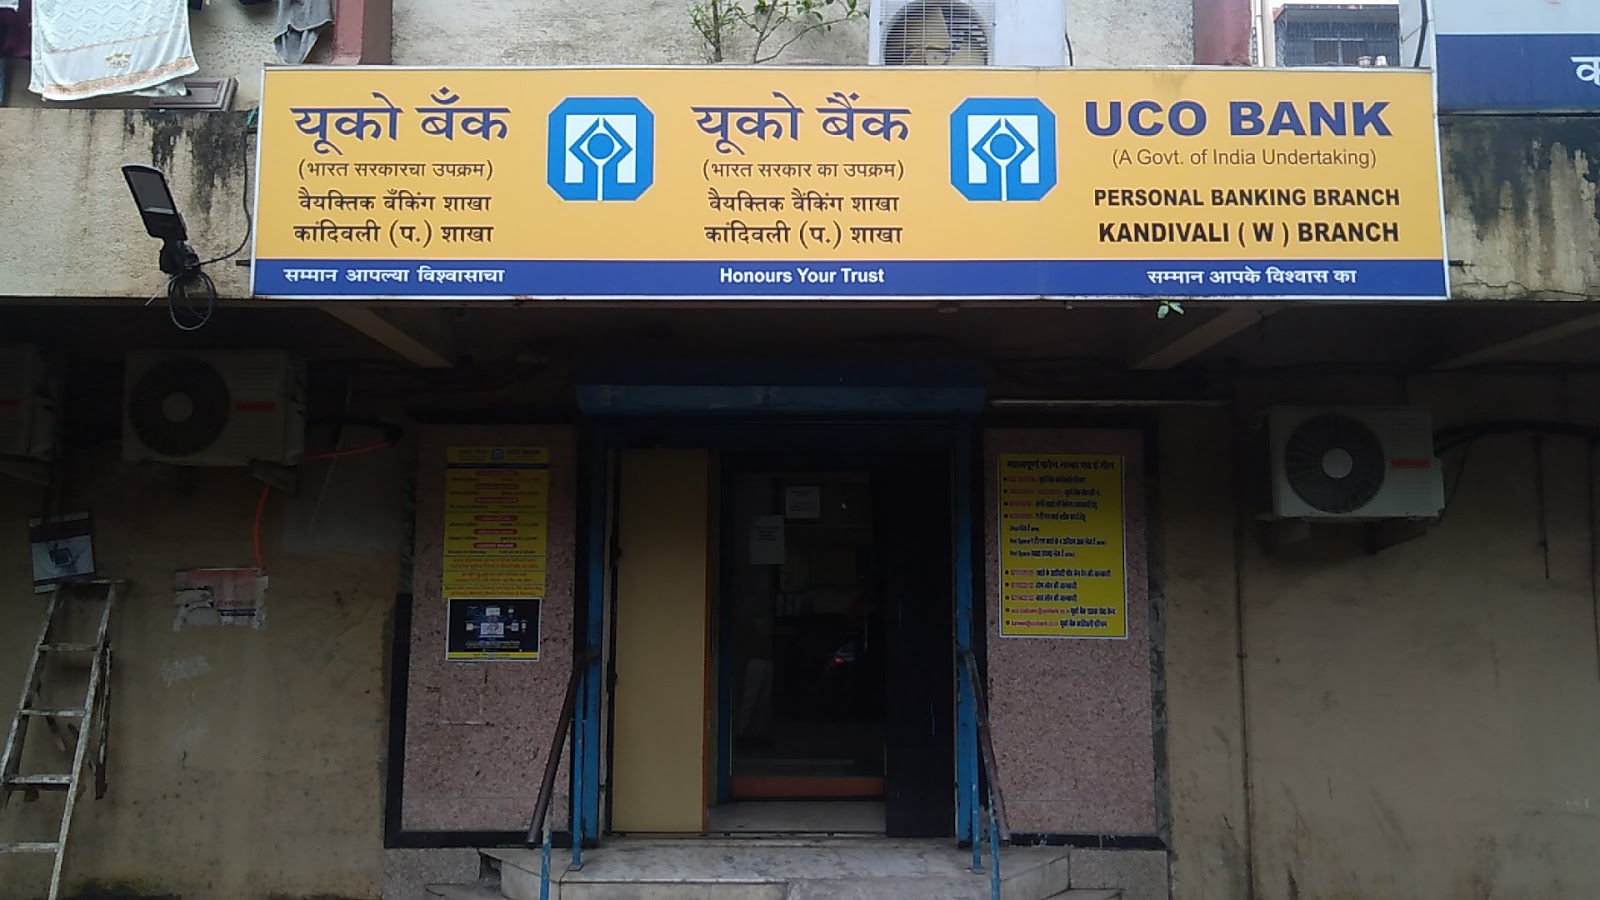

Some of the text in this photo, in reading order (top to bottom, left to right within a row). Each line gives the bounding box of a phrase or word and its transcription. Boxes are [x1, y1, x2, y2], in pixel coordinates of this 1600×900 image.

[289, 92, 404, 156] यूको
[691, 91, 912, 156] यूको बैंक
[1085, 100, 1393, 137] UCO BANK
[1112, 148, 1376, 169] (A Govt. of India Undertaking)
[298, 159, 493, 181] (भारत सरकारचा उपक्रम)
[703, 159, 904, 181] (भारत सरकार का उपक्रम)
[298, 186, 377, 211] वैयक्तिक
[442, 196, 492, 212] शाखा
[707, 187, 900, 212] वैयक्तिक बैंकिंग शाखा
[1094, 188, 1400, 206] PERSONAL BANKING BRANCH
[292, 219, 495, 248] कांदिवली (प.) शाखा
[703, 219, 903, 249] कांदिवली (प.) शाखा
[1098, 222, 1229, 243] KANDIVALI
[1297, 221, 1399, 243] BRANCH
[283, 265, 506, 284] सम्मान आपल्या विश्वासाचा
[720, 267, 885, 283] Honours Your Trust
[1146, 265, 1358, 284] सम्मान आपके विश्वास का
